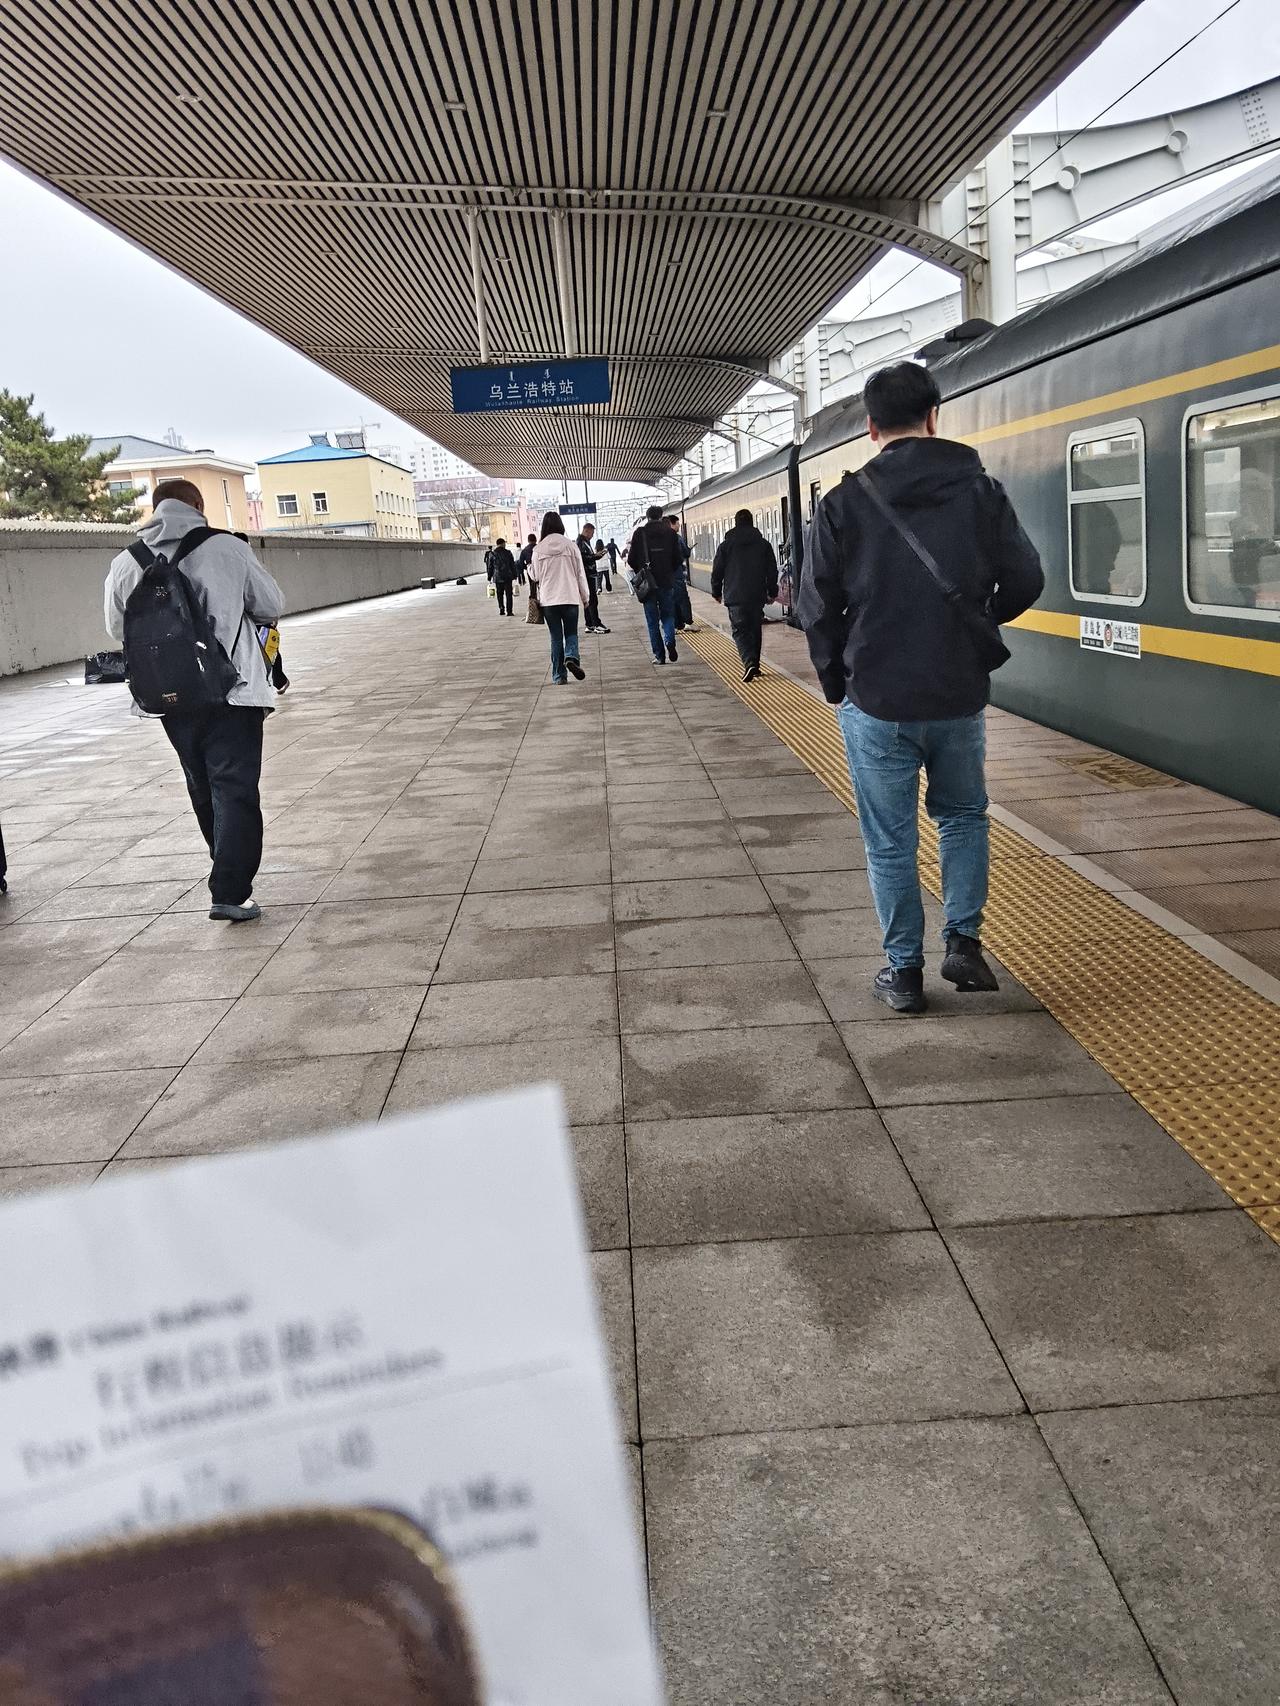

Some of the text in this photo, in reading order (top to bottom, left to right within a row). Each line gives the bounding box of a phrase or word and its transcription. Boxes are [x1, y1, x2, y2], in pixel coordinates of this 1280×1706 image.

[489, 379, 574, 400] 乌兰浩特站
[526, 397, 552, 405] Railway
[556, 395, 580, 403] Station
